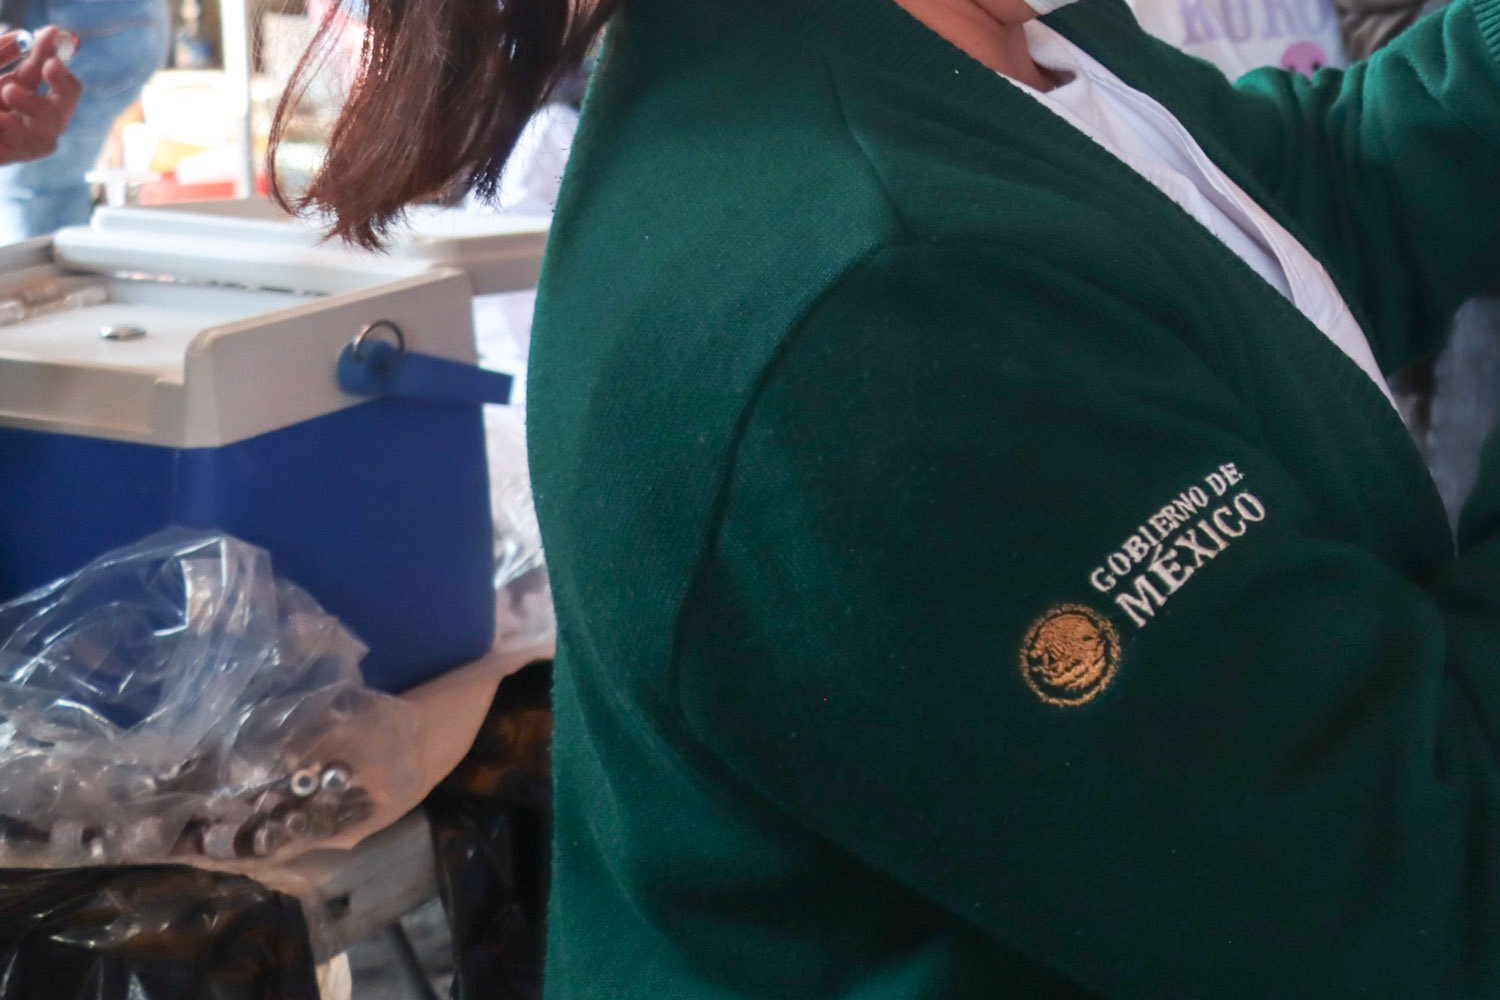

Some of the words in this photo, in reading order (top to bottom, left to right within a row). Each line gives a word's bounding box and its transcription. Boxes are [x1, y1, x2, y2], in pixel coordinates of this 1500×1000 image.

[1089, 486, 1209, 592] GOBIERNO
[1204, 462, 1245, 497] DE
[1115, 491, 1266, 628] MÉXICO
